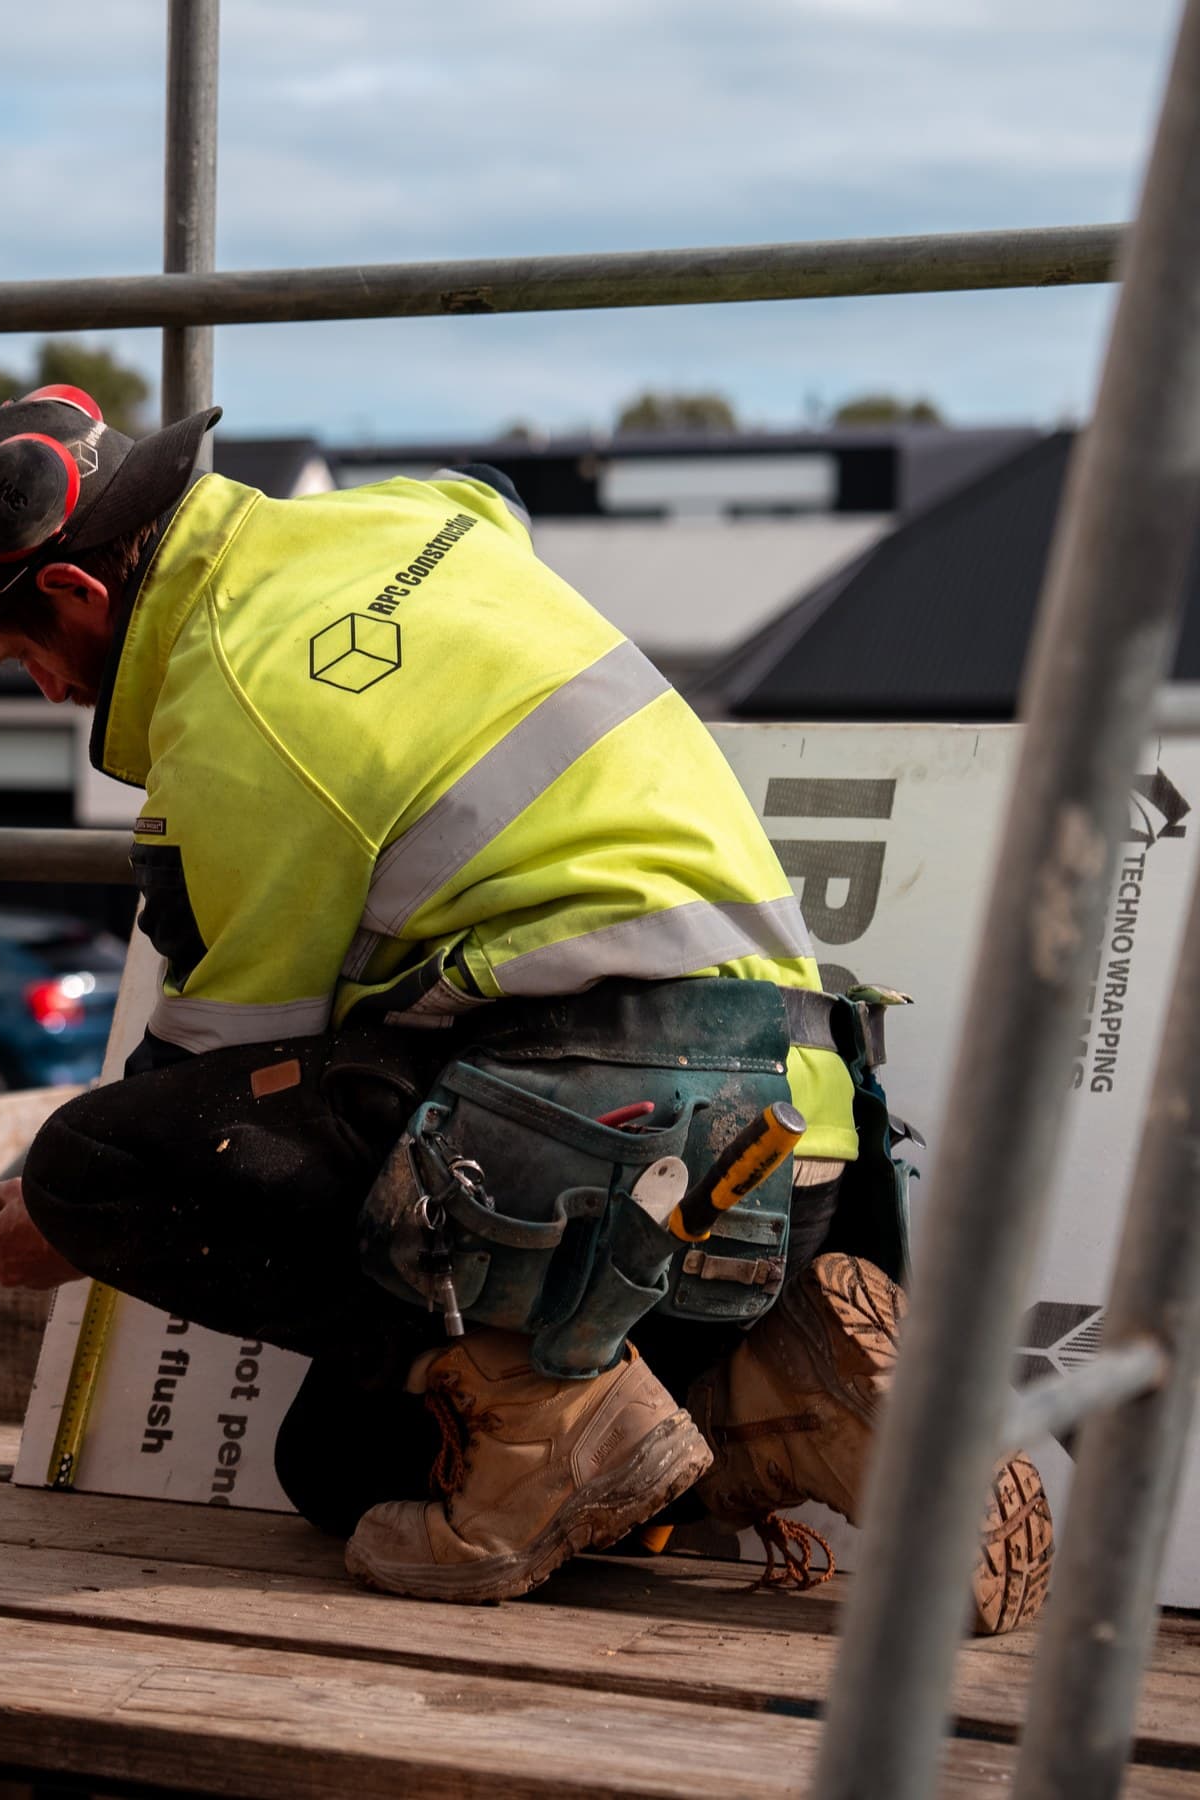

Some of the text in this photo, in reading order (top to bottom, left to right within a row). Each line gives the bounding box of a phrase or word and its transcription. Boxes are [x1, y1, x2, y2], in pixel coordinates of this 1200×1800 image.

[367, 513, 478, 615] RPC Construction
[763, 777, 897, 996] IB
[1091, 852, 1145, 1093] TECHNO WRAPPING
[141, 1349, 190, 1453] flush
[230, 1337, 263, 1401] not
